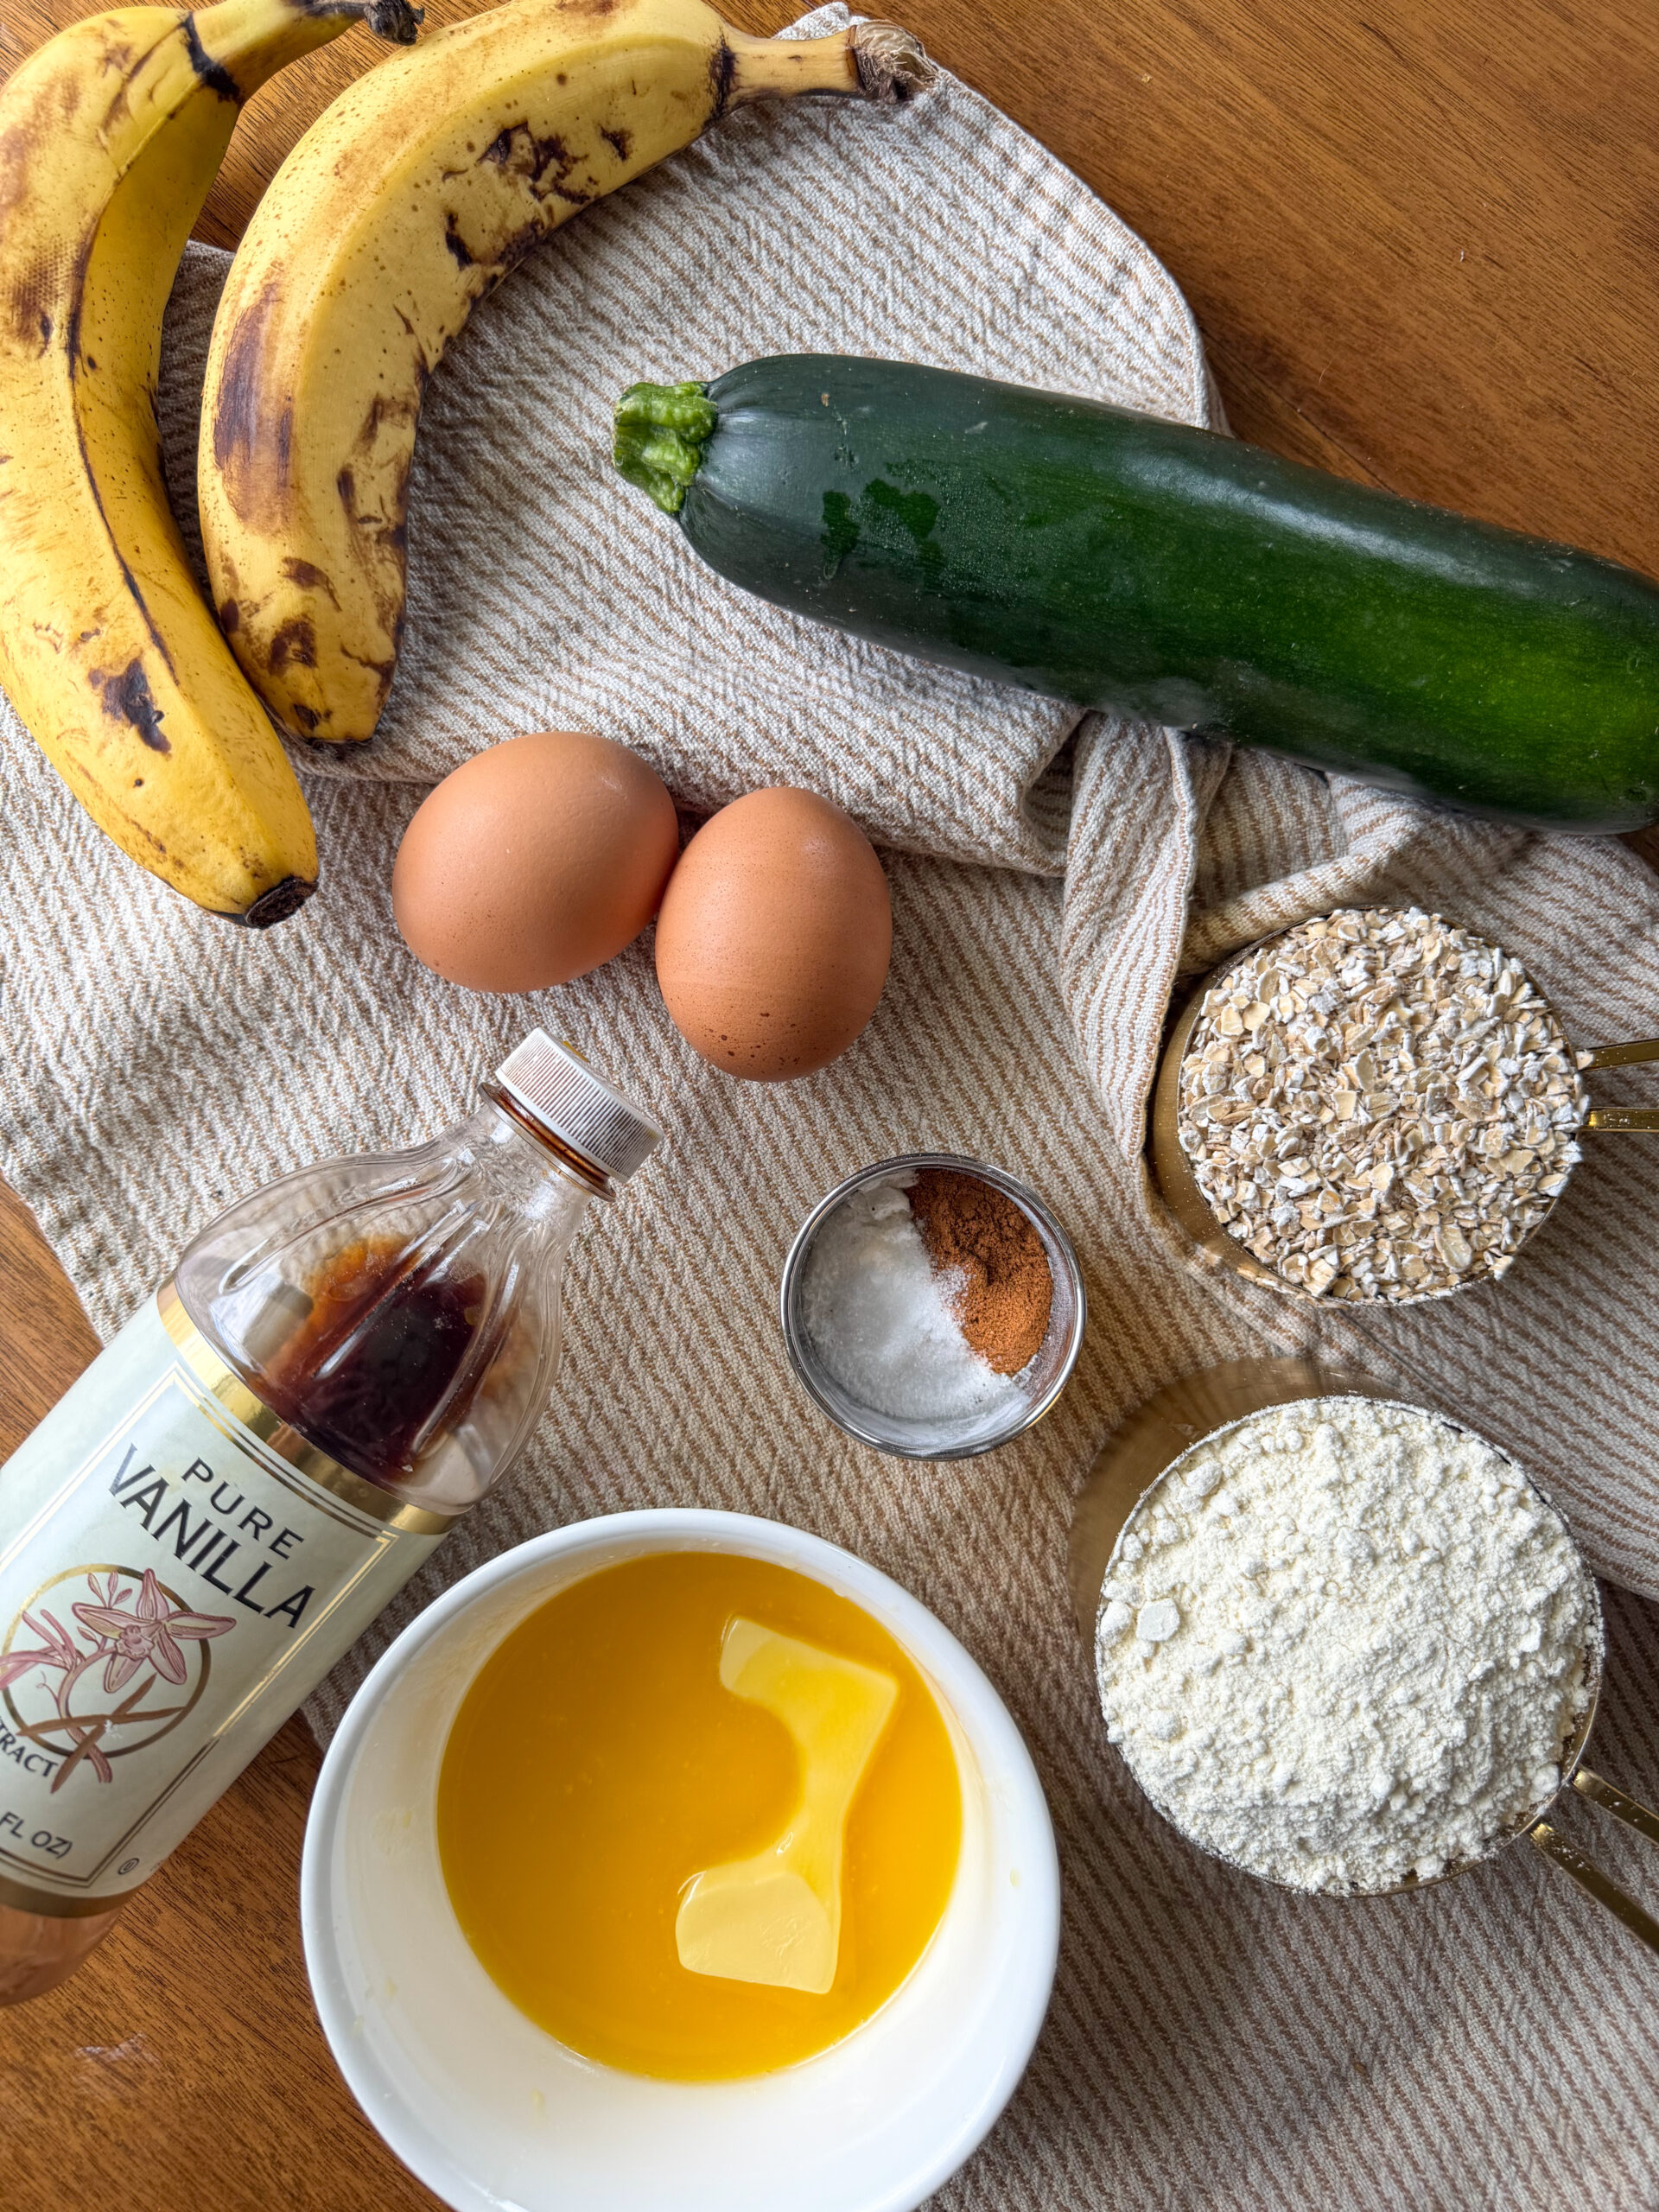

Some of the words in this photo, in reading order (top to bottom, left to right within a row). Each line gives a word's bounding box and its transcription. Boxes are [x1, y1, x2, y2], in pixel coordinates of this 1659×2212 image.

[108, 1443, 316, 1629] VANILLA
[181, 1457, 305, 1560] PURE
[0, 1811, 24, 1839] FL
[30, 1830, 73, 1859] OZ)
